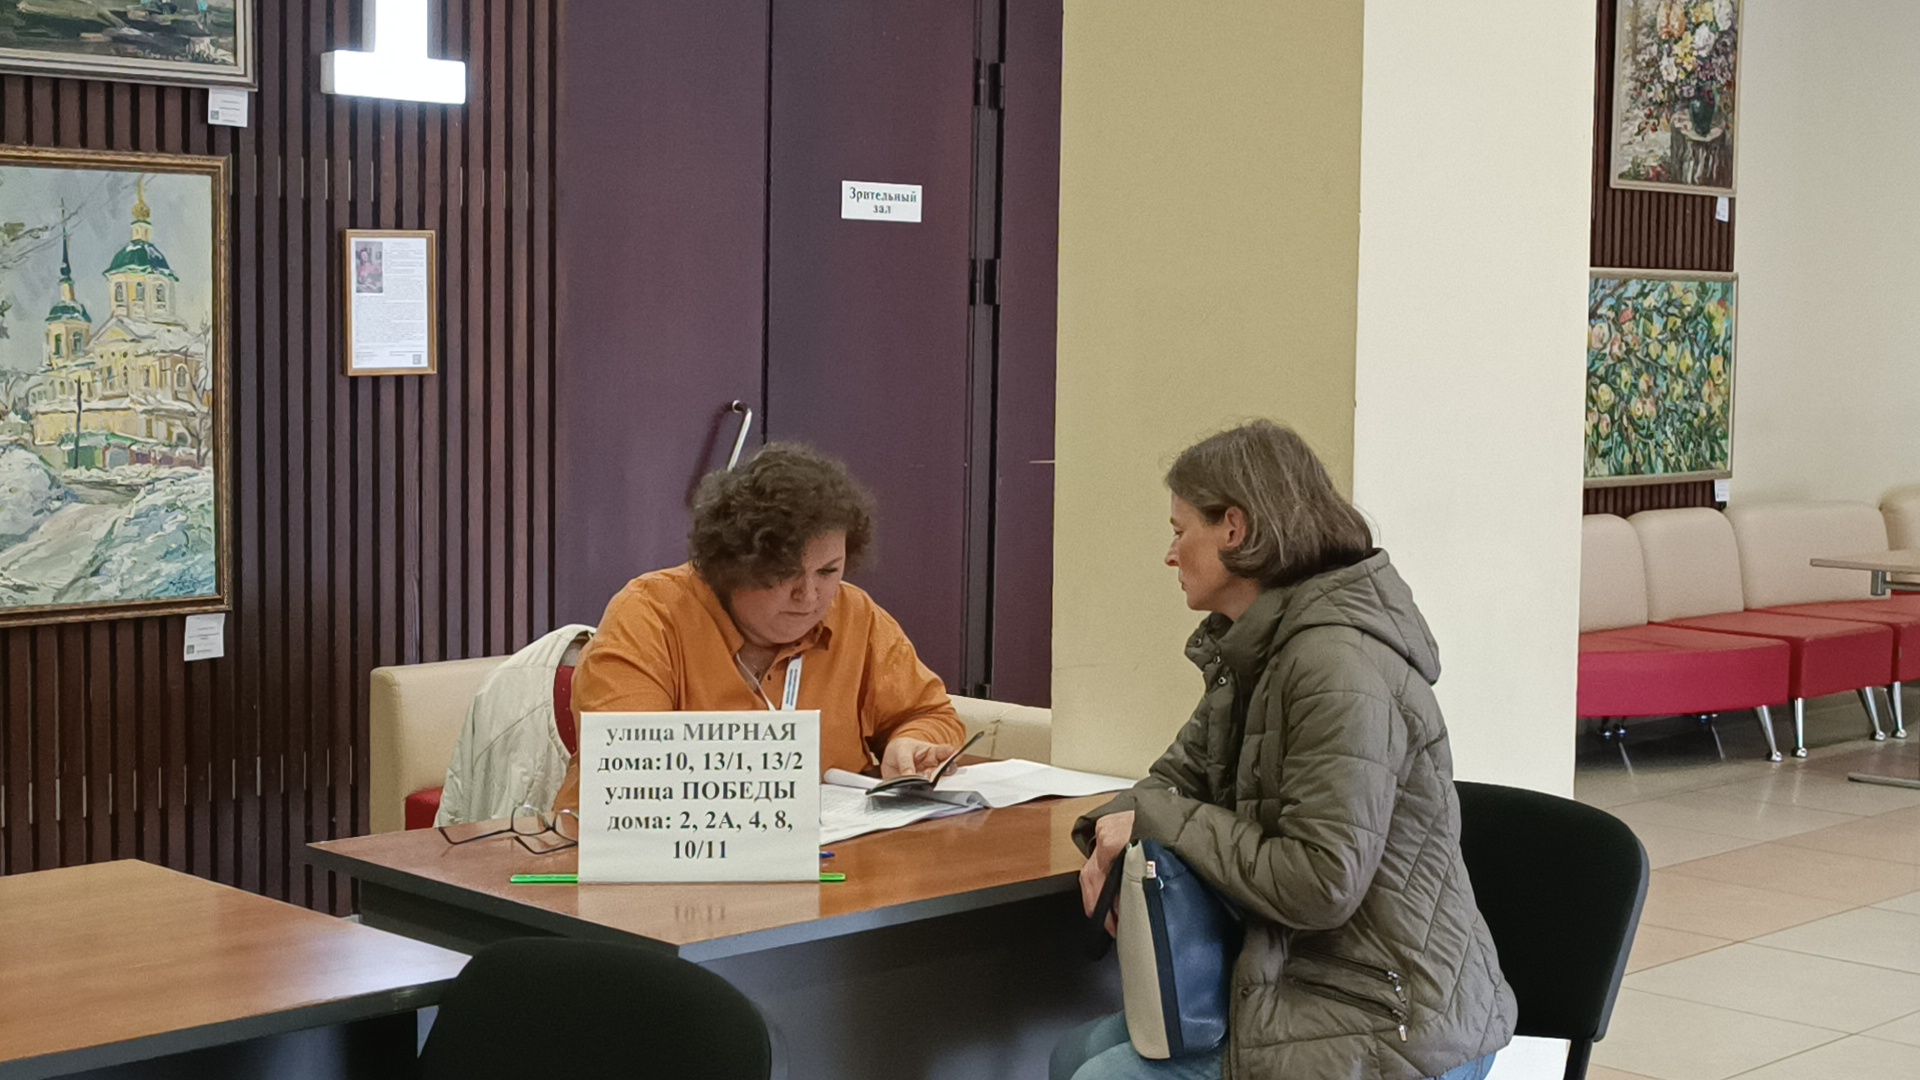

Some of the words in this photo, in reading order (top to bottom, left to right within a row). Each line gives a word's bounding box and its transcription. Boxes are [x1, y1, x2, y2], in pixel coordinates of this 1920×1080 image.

[849, 186, 917, 203] Зрительный
[873, 205, 892, 214] зал
[605, 727, 675, 747] улица
[682, 722, 797, 741] МИРНАЯ
[703, 751, 752, 773] 13/1,
[761, 751, 803, 771] 13/2
[605, 786, 674, 805] улица
[681, 780, 796, 802] ПОБЕДЫ
[606, 815, 671, 831] дома:
[679, 810, 698, 832] 2,
[704, 810, 742, 832] 2А,
[748, 810, 768, 832] 4,
[774, 810, 793, 832] 8,
[673, 839, 728, 860] 10/11
